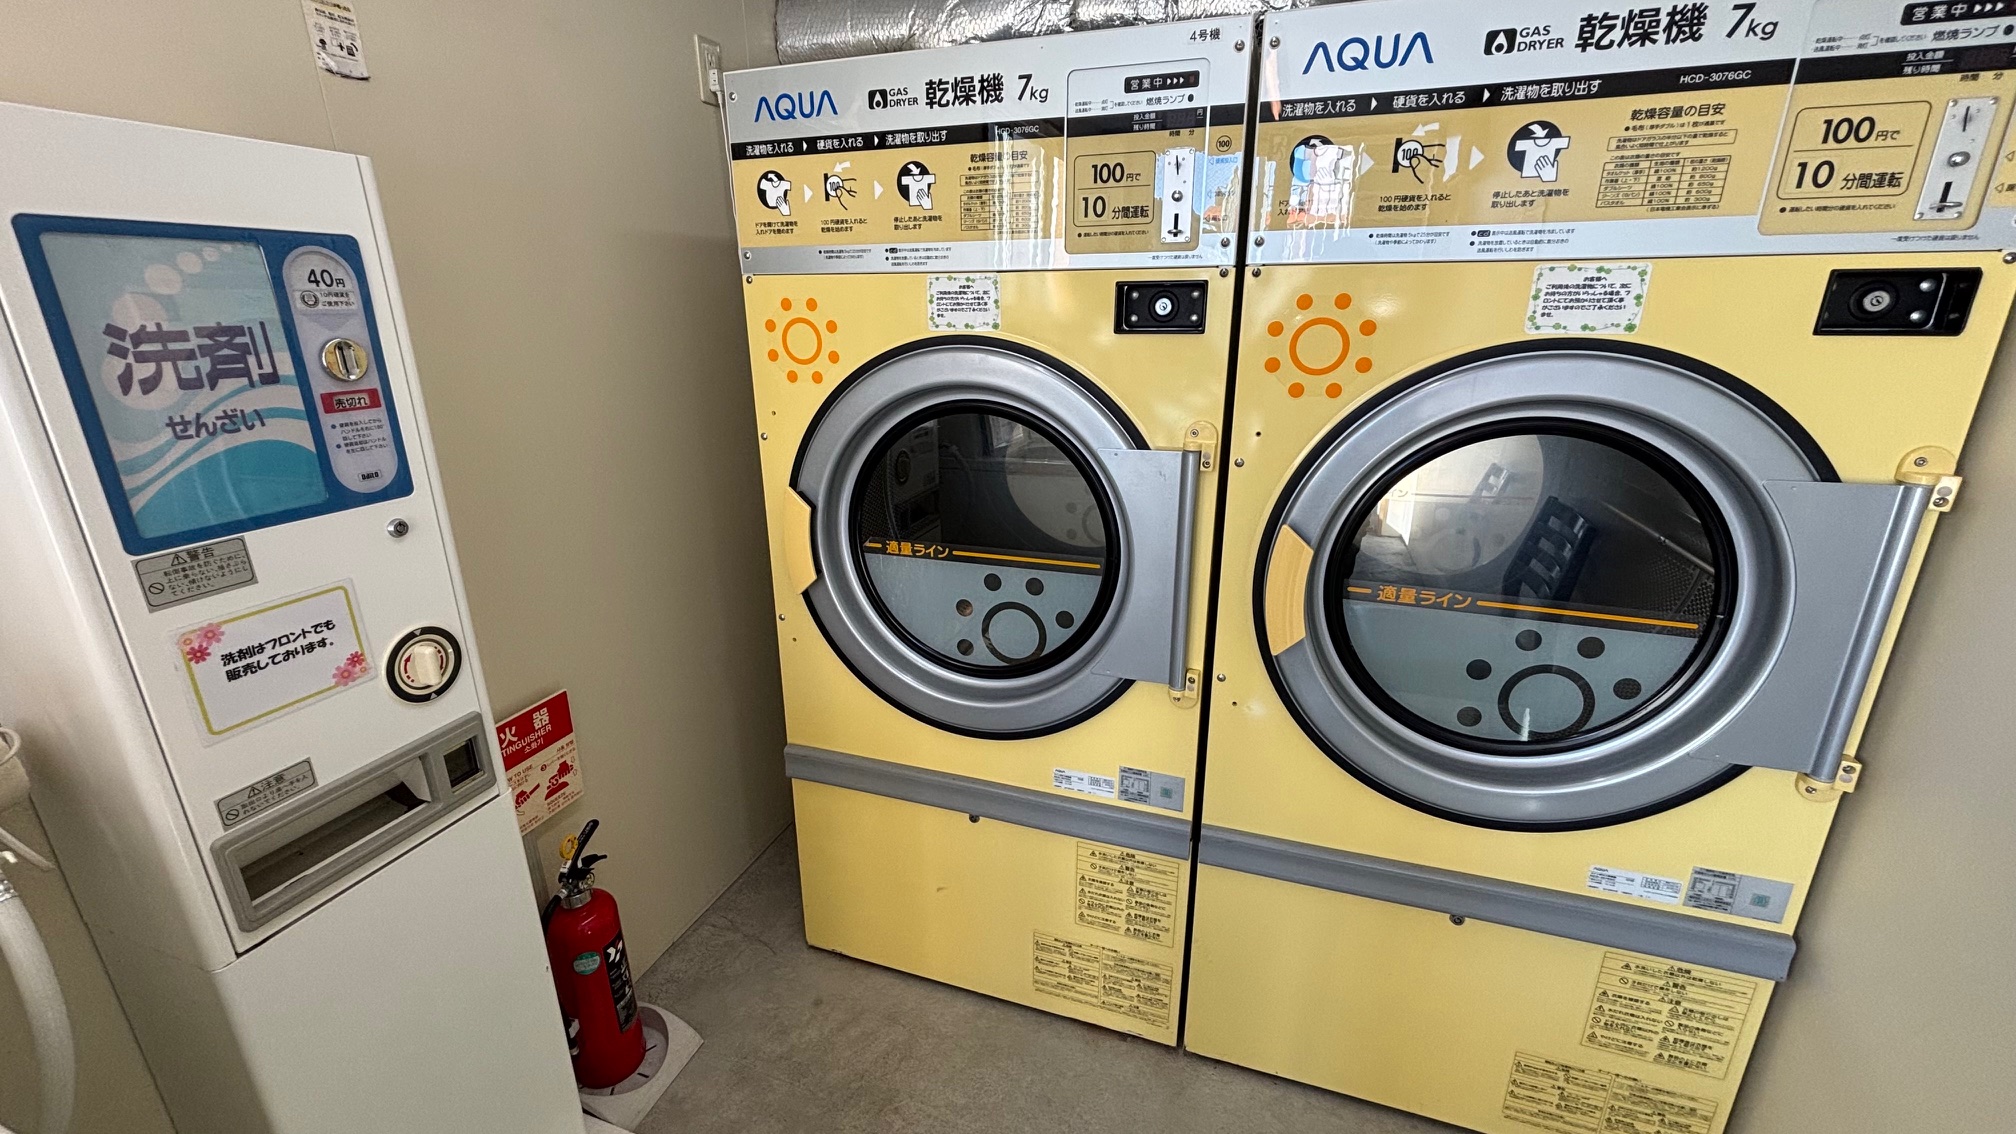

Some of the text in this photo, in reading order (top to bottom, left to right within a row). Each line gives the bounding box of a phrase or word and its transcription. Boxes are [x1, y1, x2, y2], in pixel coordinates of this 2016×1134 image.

[1912, 3, 1968, 21] 営業中
[1190, 28, 1221, 42] 4号機
[1519, 25, 1551, 38] GAS
[1575, 2, 1779, 53] 乾燥機 7kg
[1931, 25, 2000, 42] 燃焼ランプ
[1302, 31, 1434, 75] AQUA
[1517, 37, 1565, 52] DRYER
[1906, 51, 1945, 61] 投入金額
[1680, 70, 1752, 84] HCD-3076GC
[1902, 65, 1941, 75] 残り時間
[889, 87, 908, 97] GAS
[925, 72, 1049, 109] 乾燥機 7kg
[1130, 77, 1163, 91] 営業中
[754, 89, 838, 122] AQUA
[889, 97, 919, 107] DRYER
[1146, 94, 1185, 106] 燃焼ランプ
[1282, 79, 1602, 117] 洗濯物を入れる 硬貨を入れる 洗濯物を取り出す
[1133, 112, 1156, 120] 投入金額
[1630, 103, 1726, 121] 乾燥容量の目安
[1132, 122, 1156, 131] 残り時間
[1821, 116, 1901, 145] 100円で
[745, 130, 948, 156] 洗濯物を入れる 硬貨を入れる 洗濯物を取り出す
[1218, 138, 1230, 148] 100
[1091, 162, 1141, 184] 100円で
[1795, 160, 1835, 189] 10
[1840, 171, 1904, 191] 分間運転
[1492, 188, 1570, 199] 停止したあと洗濯物を
[1082, 195, 1106, 218] 10
[1111, 205, 1149, 220] 分間運転
[1378, 203, 1427, 212] 乾燥を始めます
[1491, 200, 1537, 208] 取り出します
[893, 214, 942, 223] 停止したあと洗濯物を
[894, 223, 922, 231] 取り出します
[307, 269, 345, 288] 40円
[102, 321, 280, 396] 洗剤
[335, 396, 368, 409] 売切れ
[165, 408, 266, 440] せんざい
[186, 547, 214, 561] 警告
[885, 540, 949, 558] 適量ライン
[1377, 585, 1472, 608] 適量ライン
[220, 619, 336, 667] 洗剤はフロントでも
[225, 639, 334, 682] 販売しております。
[500, 707, 549, 748] 火 器
[261, 773, 285, 791] 注意
